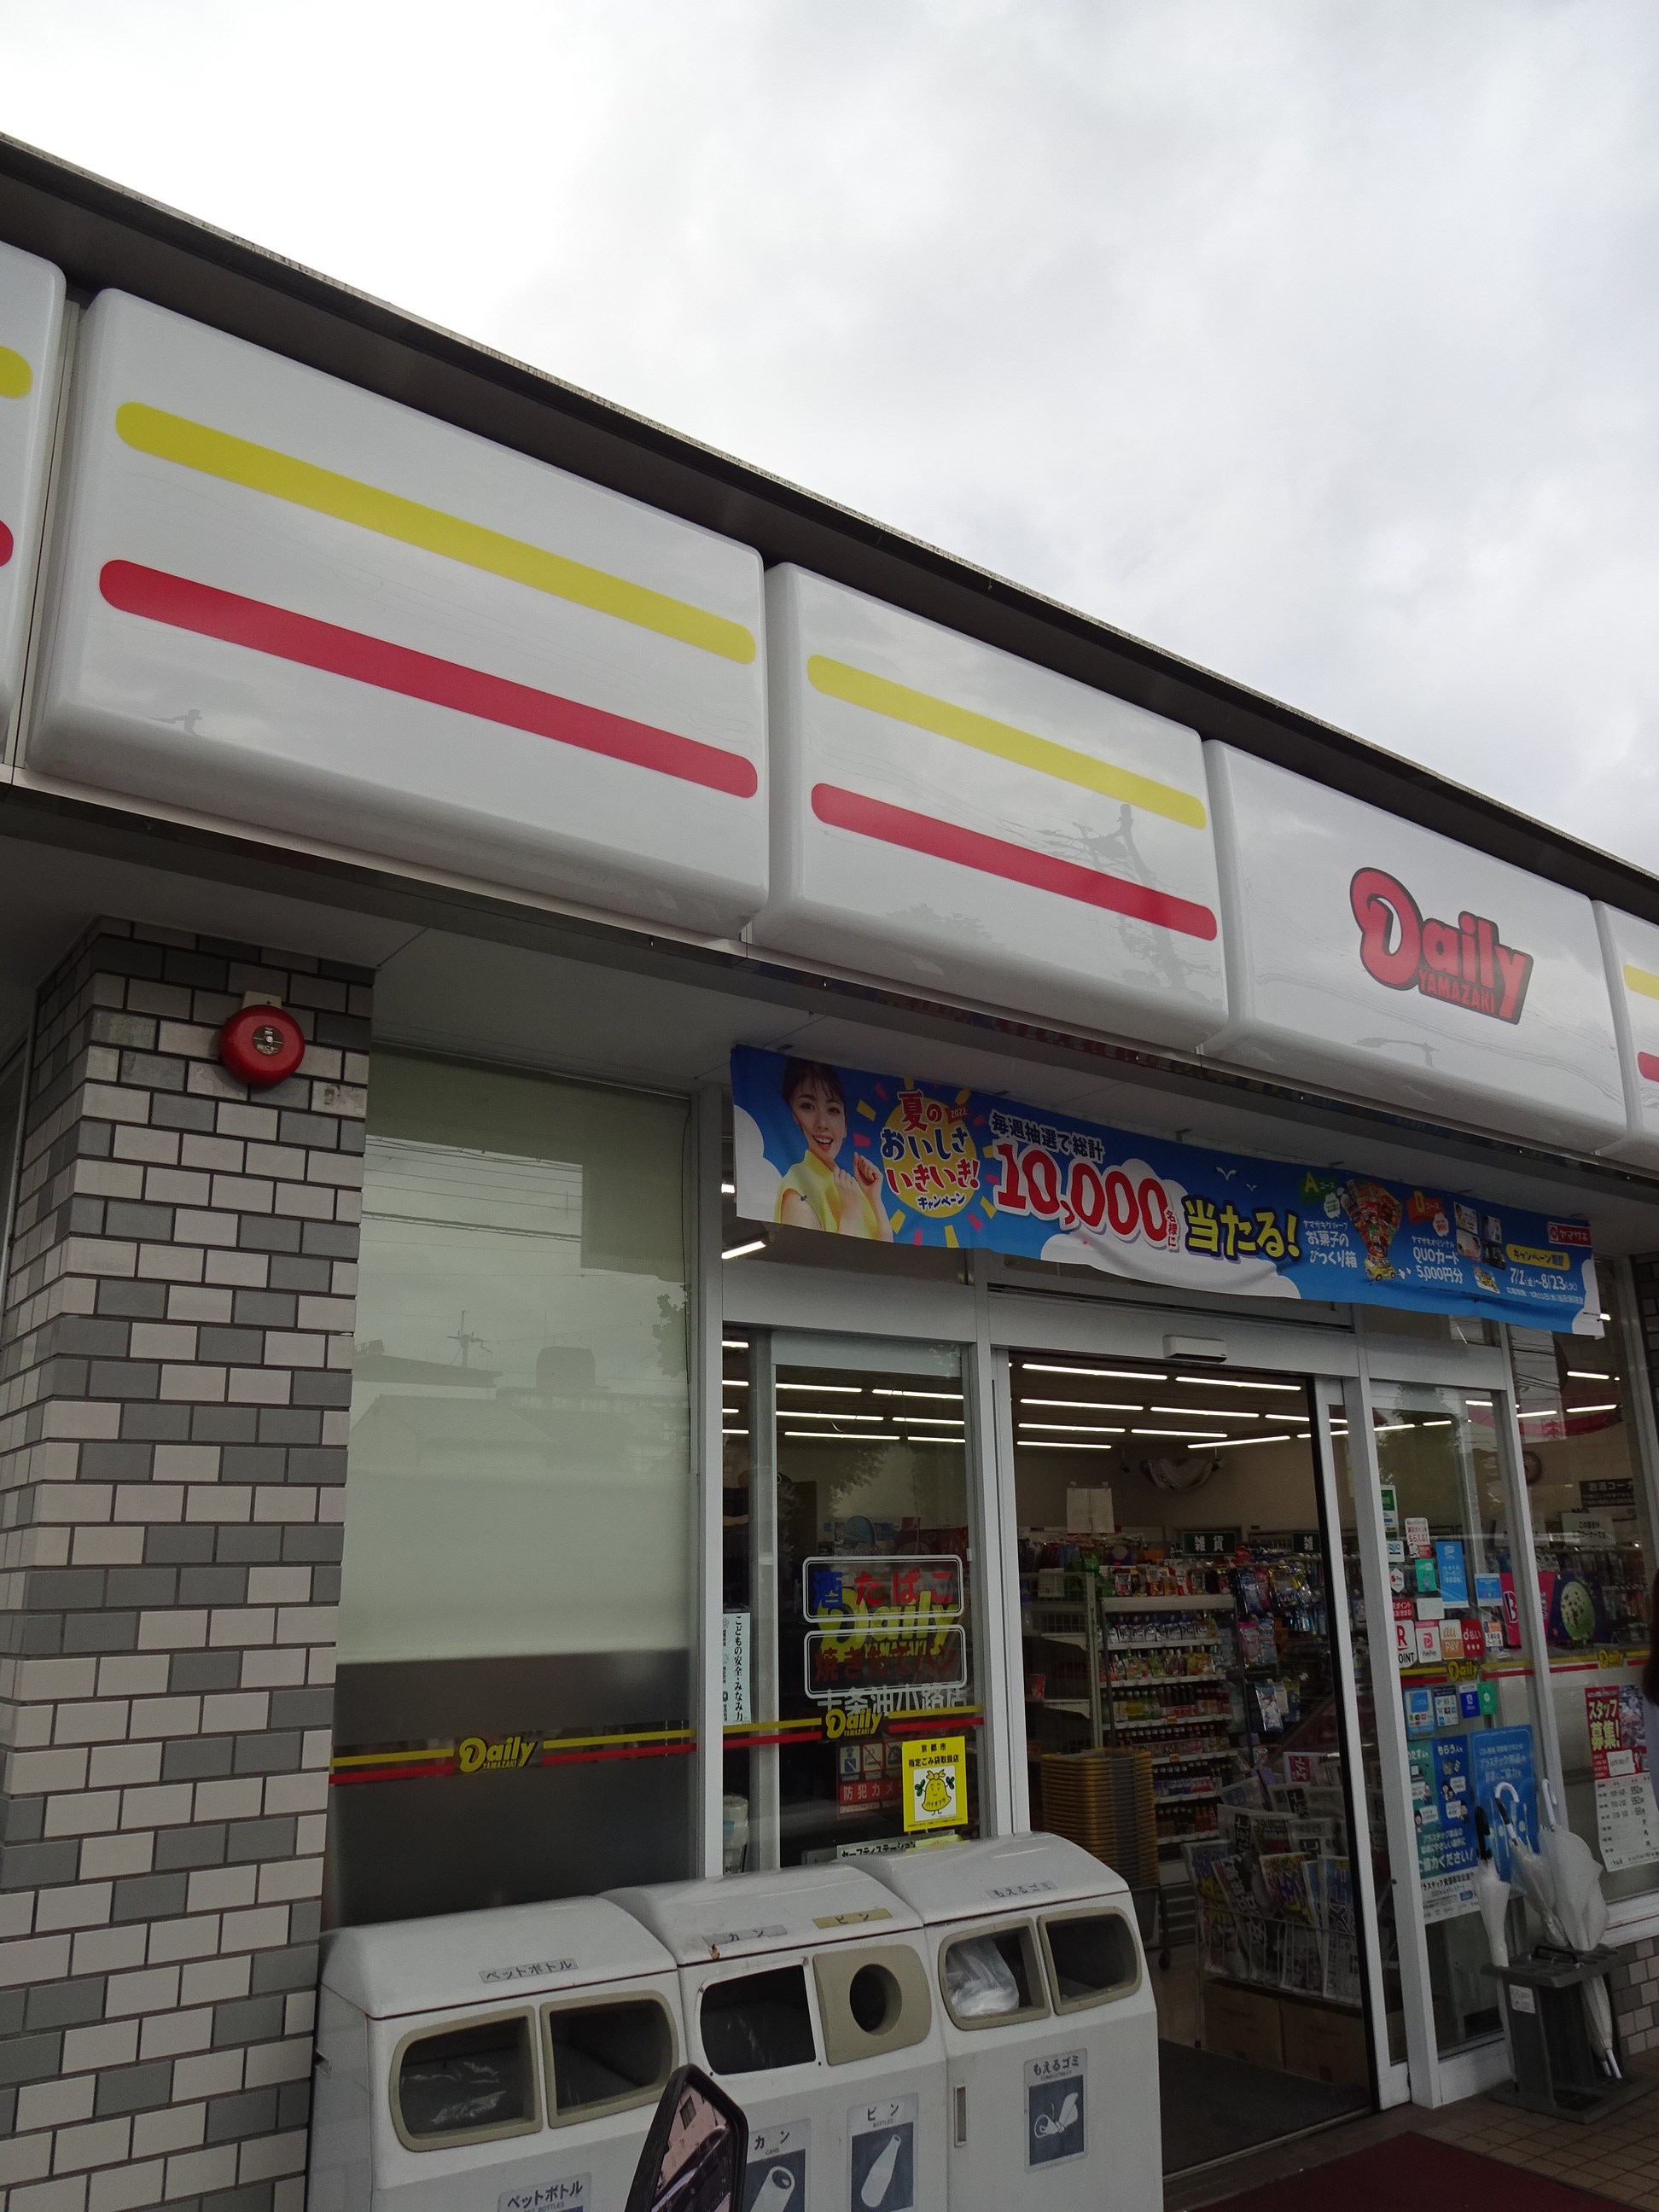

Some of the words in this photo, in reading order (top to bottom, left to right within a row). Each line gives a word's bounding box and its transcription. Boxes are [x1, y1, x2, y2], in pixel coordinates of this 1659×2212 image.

[1350, 867, 1534, 1024] Daily
[1418, 969, 1495, 1013] YAMAZAKI
[898, 1089, 942, 1132] 夏の
[950, 1107, 968, 1119] 2022
[881, 1126, 969, 1161] おいしさ
[991, 1112, 1104, 1161] 毎週抽選で総計
[917, 1193, 966, 1210] キャンペーン
[995, 1142, 1168, 1243] 10,000
[1184, 1196, 1301, 1260] 当たる!
[1305, 1230, 1349, 1248] お菓子の
[1309, 1247, 1358, 1268] びっくり箱
[1412, 1246, 1460, 1266] QUOカード
[1416, 1265, 1464, 1284] 5,000円分
[812, 1569, 844, 1610] 酒
[853, 1567, 956, 1607] たばこ
[815, 1586, 960, 1663] Daily
[1444, 1641, 1459, 1653] PAY
[825, 1708, 884, 1739] Daily
[843, 1728, 871, 1738] YAMAZAKI
[457, 1735, 538, 1773] Daily
[921, 1743, 947, 1753] 京都市
[483, 1760, 517, 1771] YAMAZAKI
[908, 1754, 960, 1768] 指定ごみ袋取扱店
[486, 1960, 573, 1980] ペットボトル
[1033, 2055, 1079, 2076] もえるゴミ
[754, 2129, 790, 2151] カン
[507, 2180, 583, 2209] ペットボトル
